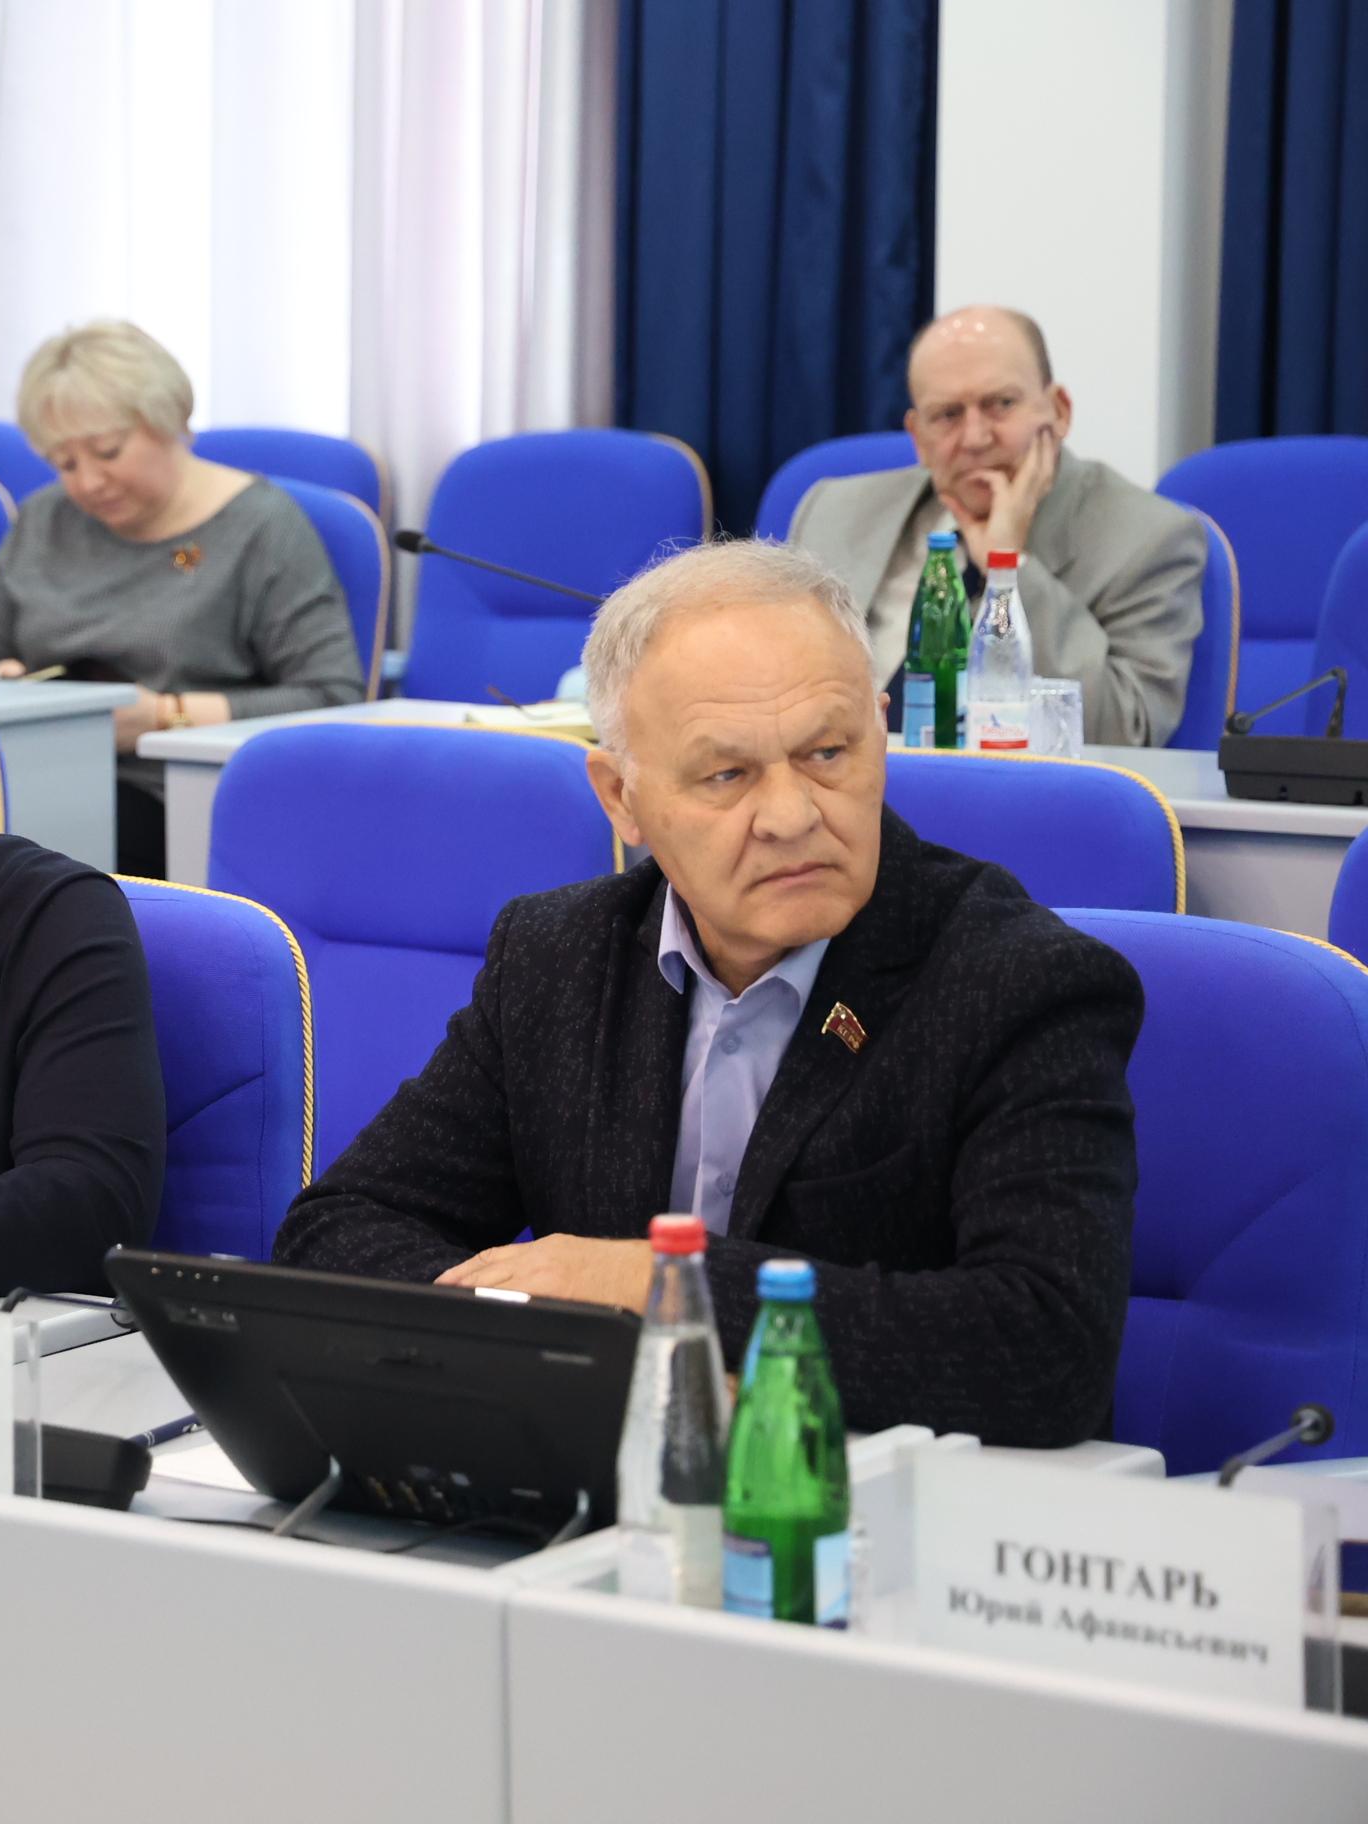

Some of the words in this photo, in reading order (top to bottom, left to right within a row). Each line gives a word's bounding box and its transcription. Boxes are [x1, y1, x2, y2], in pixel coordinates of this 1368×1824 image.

[992, 1539, 1220, 1611] ГОНТАРЬ
[947, 1585, 1043, 1626] Юрий
[1055, 1606, 1269, 1664] Афанасьевич
